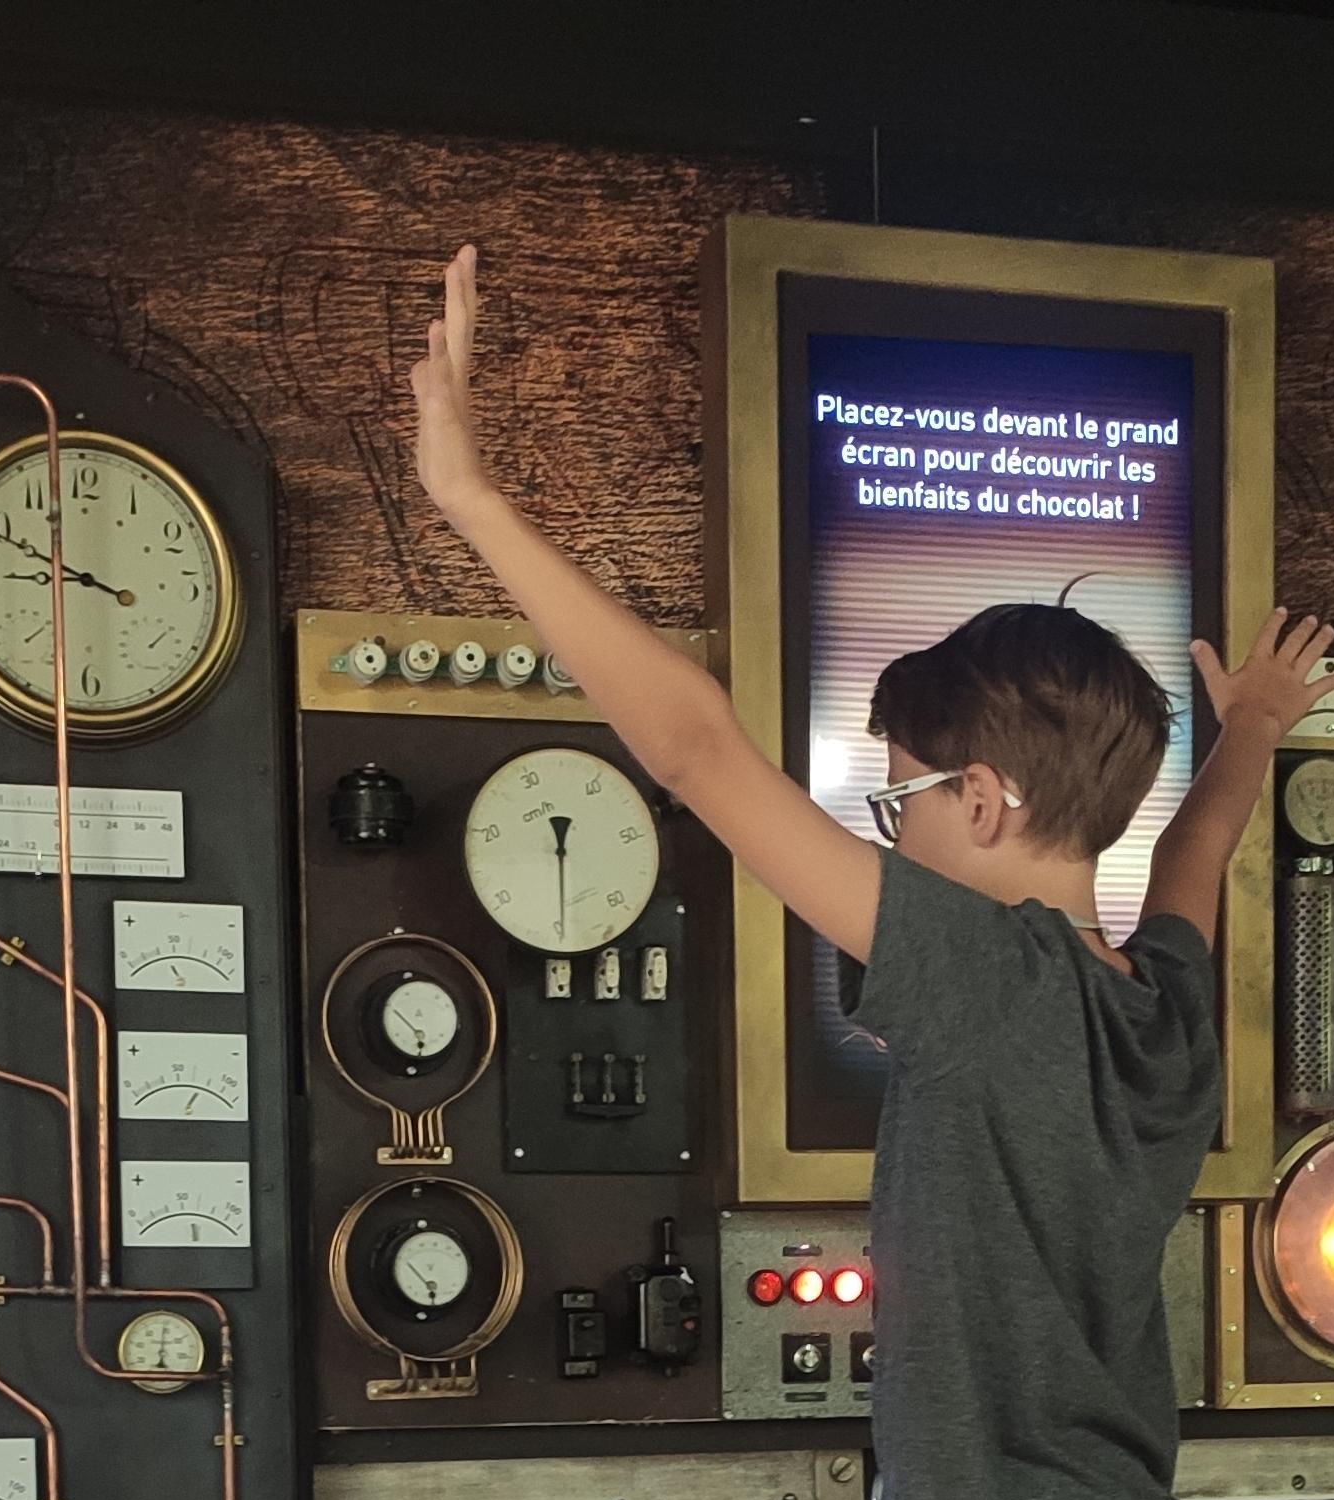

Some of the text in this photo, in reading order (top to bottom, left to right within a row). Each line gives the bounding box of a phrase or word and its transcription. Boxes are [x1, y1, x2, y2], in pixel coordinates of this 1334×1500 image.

[817, 394, 1179, 448] Placez-vous devant le grand
[841, 436, 1156, 483] écran pour découvrir les
[25, 478, 44, 510] 11
[71, 466, 101, 500] 12
[130, 482, 137, 515] 1
[859, 478, 970, 511] bienfaits
[977, 486, 1009, 514] du
[1017, 489, 1124, 521] chocolat
[163, 519, 184, 554] 2
[80, 663, 101, 697] 6
[520, 771, 540, 790] 30
[585, 779, 602, 796] 40
[522, 801, 556, 823] cm/h
[484, 824, 500, 842] 20
[618, 826, 638, 844] 50
[606, 890, 625, 908] 60
